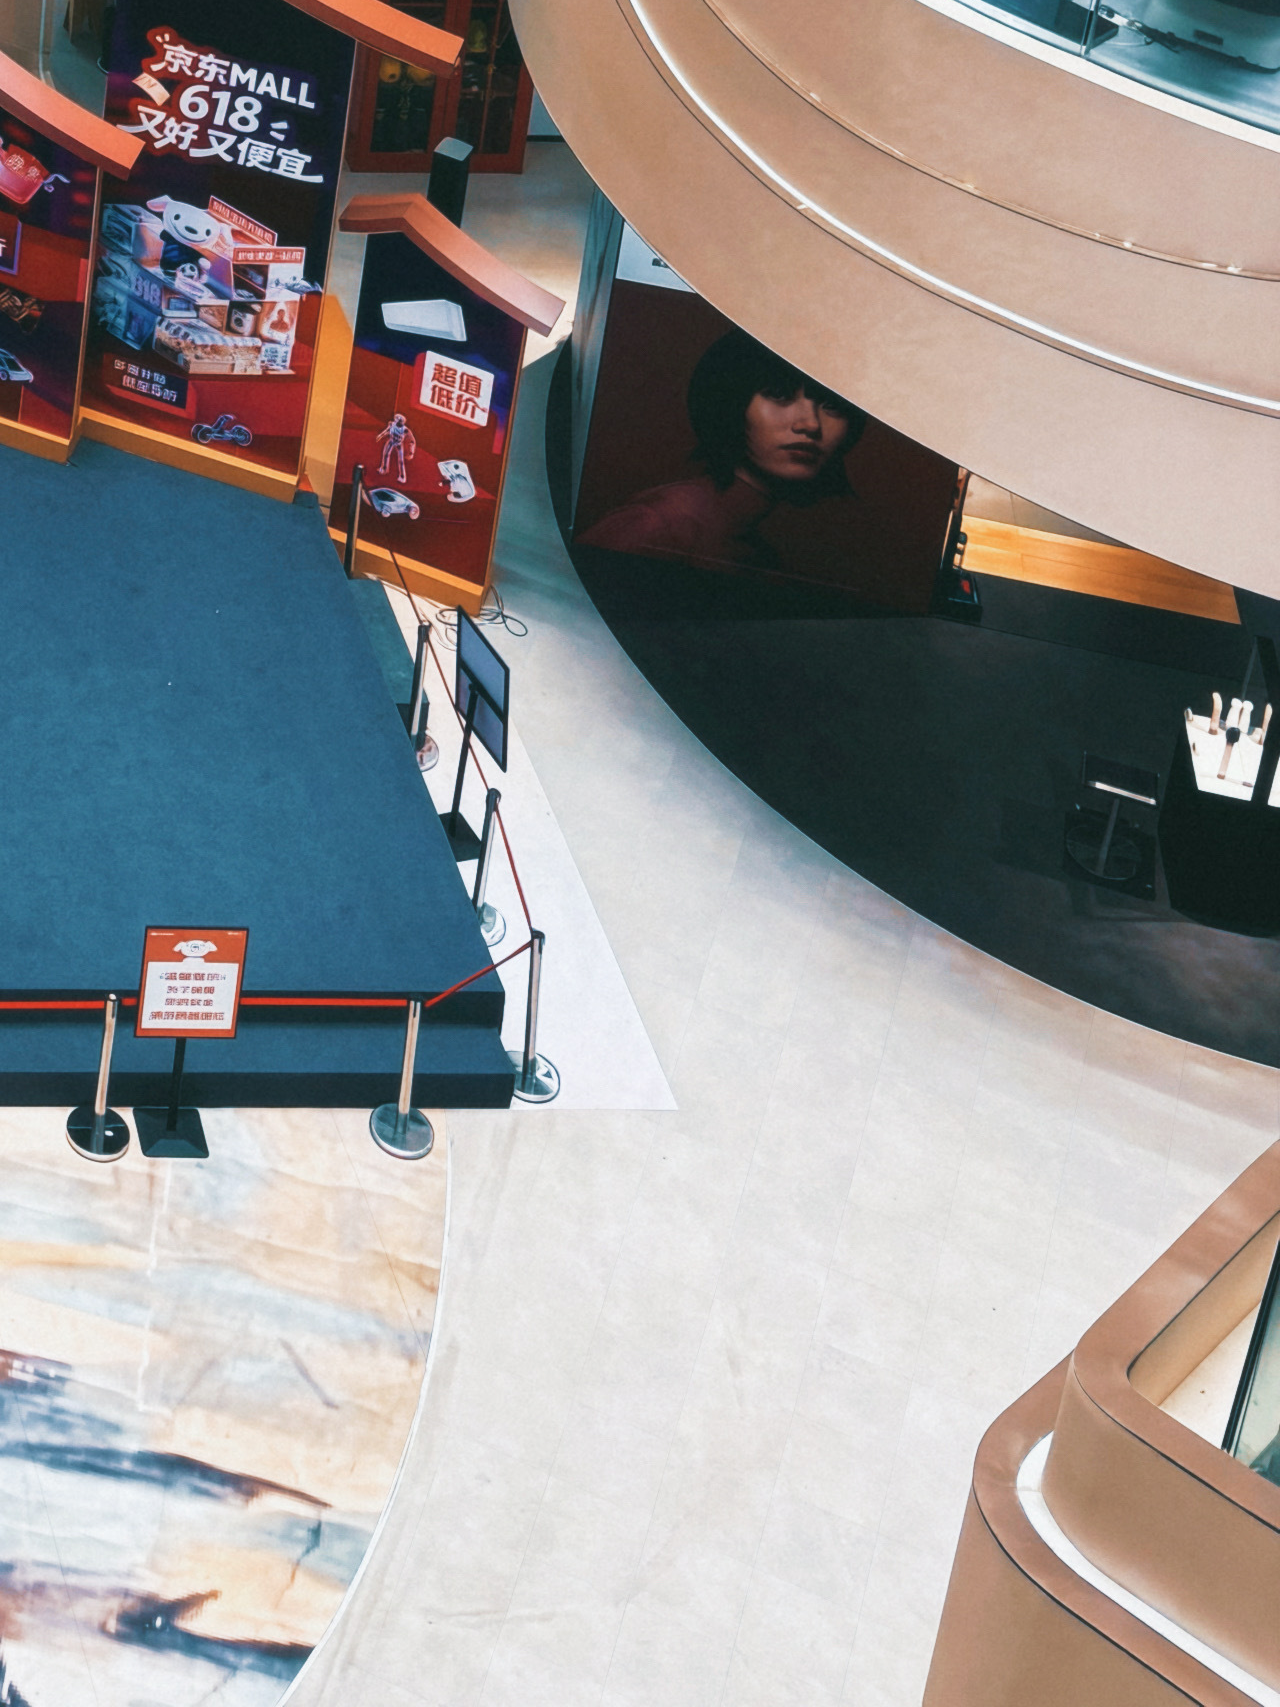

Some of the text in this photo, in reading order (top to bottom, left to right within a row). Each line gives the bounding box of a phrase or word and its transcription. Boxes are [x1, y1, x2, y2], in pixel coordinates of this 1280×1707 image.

[150, 43, 316, 110] 京东MALL
[179, 84, 263, 134] 618
[116, 104, 324, 184] 又好又便宜
[429, 383, 484, 420] 低价
[430, 361, 484, 399] 超值
